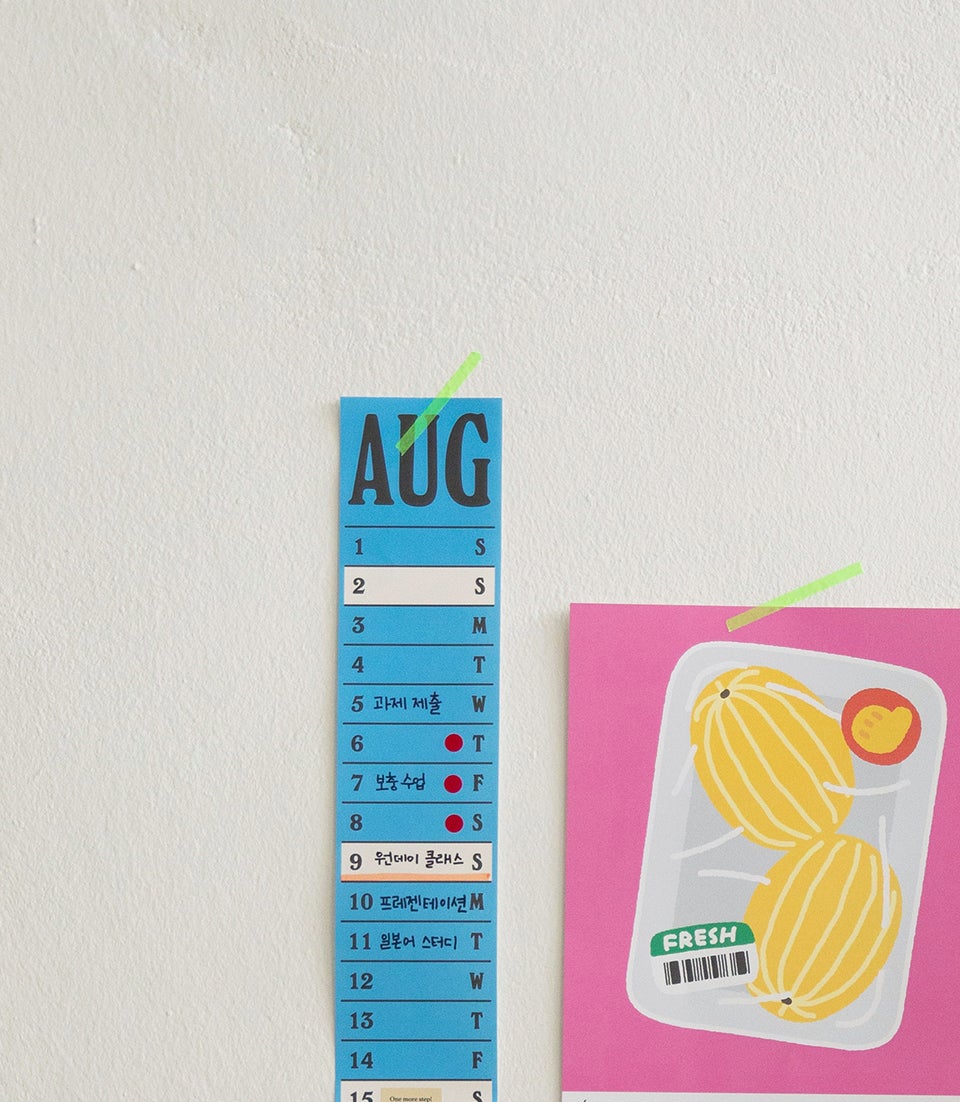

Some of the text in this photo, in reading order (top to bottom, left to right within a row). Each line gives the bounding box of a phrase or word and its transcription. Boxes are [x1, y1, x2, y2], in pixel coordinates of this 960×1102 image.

[348, 412, 491, 507] AUG
[354, 537, 364, 556] 1
[474, 537, 486, 556] S
[352, 577, 366, 595] 2
[474, 577, 486, 596] S
[351, 615, 366, 634] 3
[471, 616, 488, 635] M
[351, 655, 365, 674] 4
[472, 655, 486, 674] T
[350, 695, 364, 713] 5
[374, 692, 442, 715] 과제 제출
[471, 695, 487, 713] W
[350, 734, 364, 753] 6
[472, 734, 485, 753] T
[350, 773, 364, 792] 7
[472, 773, 485, 792] F
[349, 813, 363, 832] 8
[471, 813, 483, 832] S
[349, 853, 363, 871] 9
[374, 850, 464, 869] 원데이 클래스
[471, 852, 483, 871] S
[349, 892, 374, 911] 10
[469, 892, 485, 911] M
[349, 932, 371, 951] 11
[380, 933, 457, 950] 일본어 스터디
[470, 932, 484, 951] T
[662, 926, 738, 952] FRESH
[349, 972, 374, 990] 12
[469, 971, 485, 990] W
[350, 1011, 374, 1030] 13
[470, 1011, 484, 1030] T
[350, 1051, 374, 1070] 14
[471, 1050, 484, 1070] F
[389, 1095, 402, 1102] One
